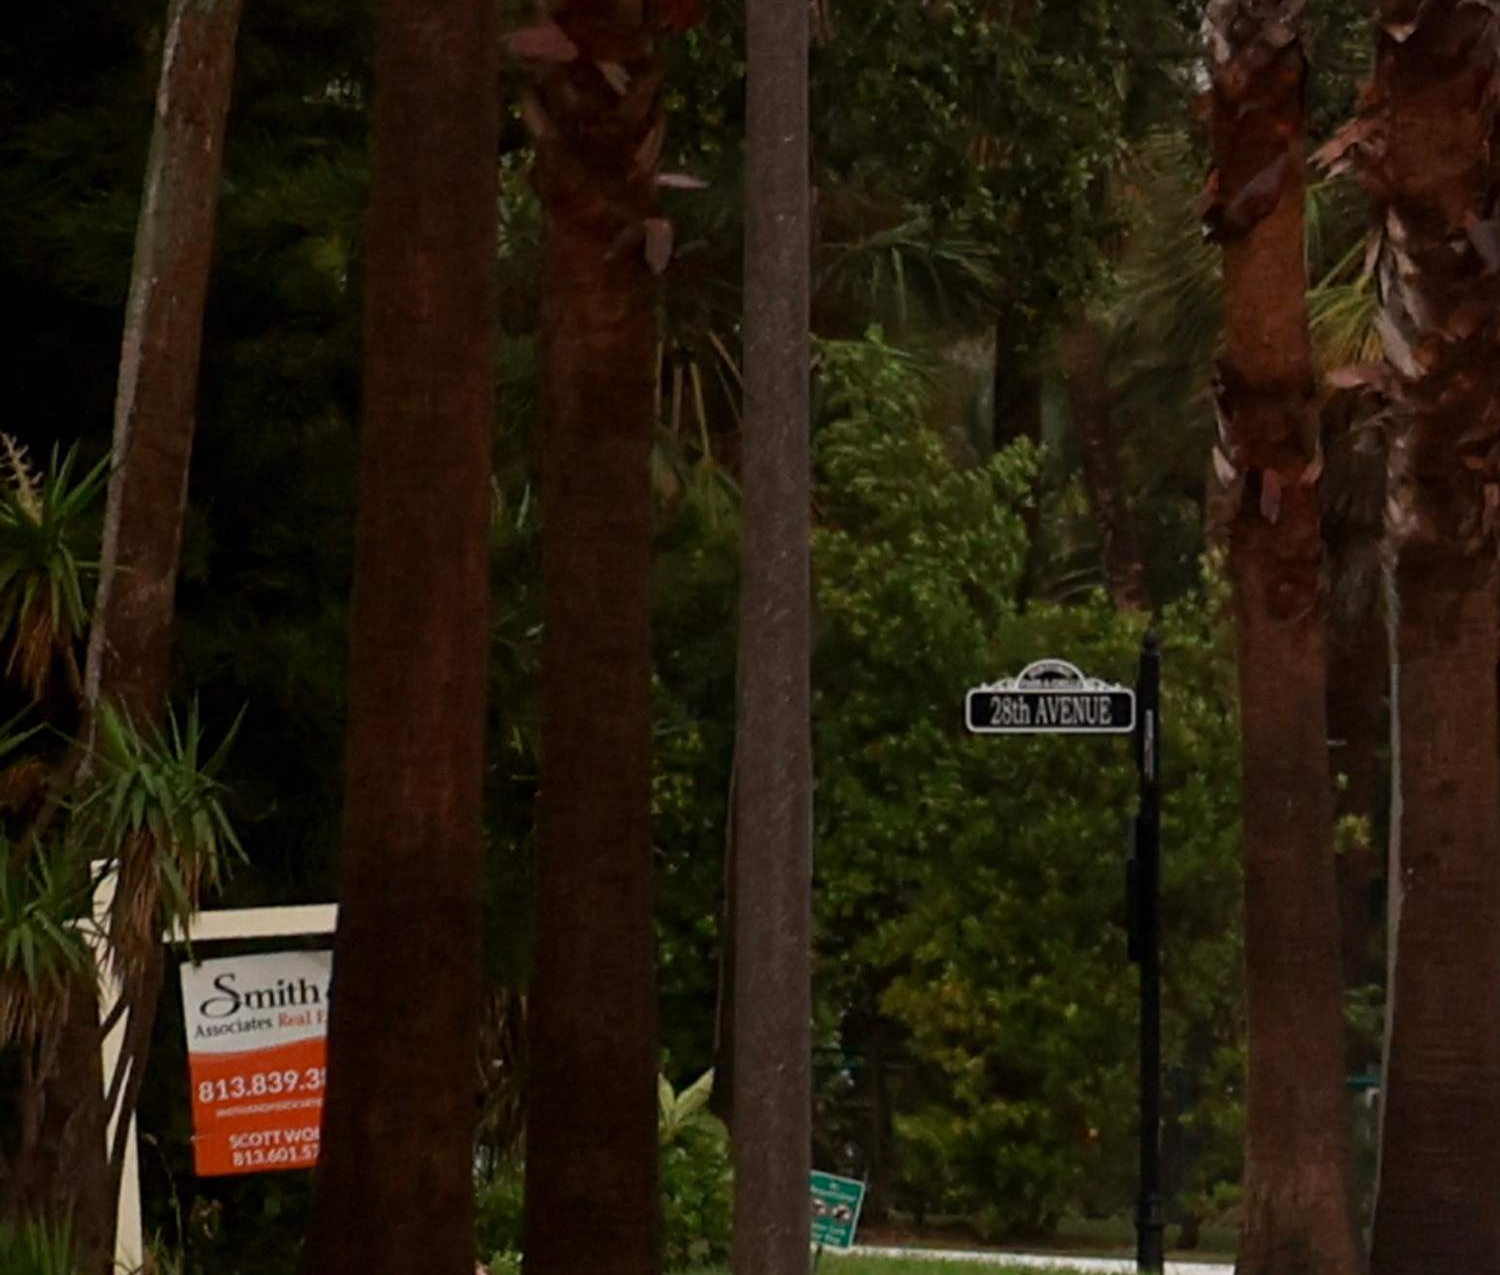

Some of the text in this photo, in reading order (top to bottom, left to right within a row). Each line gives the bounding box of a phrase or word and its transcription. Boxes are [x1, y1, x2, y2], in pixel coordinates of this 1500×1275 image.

[990, 696, 1112, 725] 28th AVENUE
[200, 972, 320, 1019] Smith
[194, 1016, 273, 1039] Associates
[277, 1009, 312, 1028] Real
[228, 1129, 282, 1150] SCOTT
